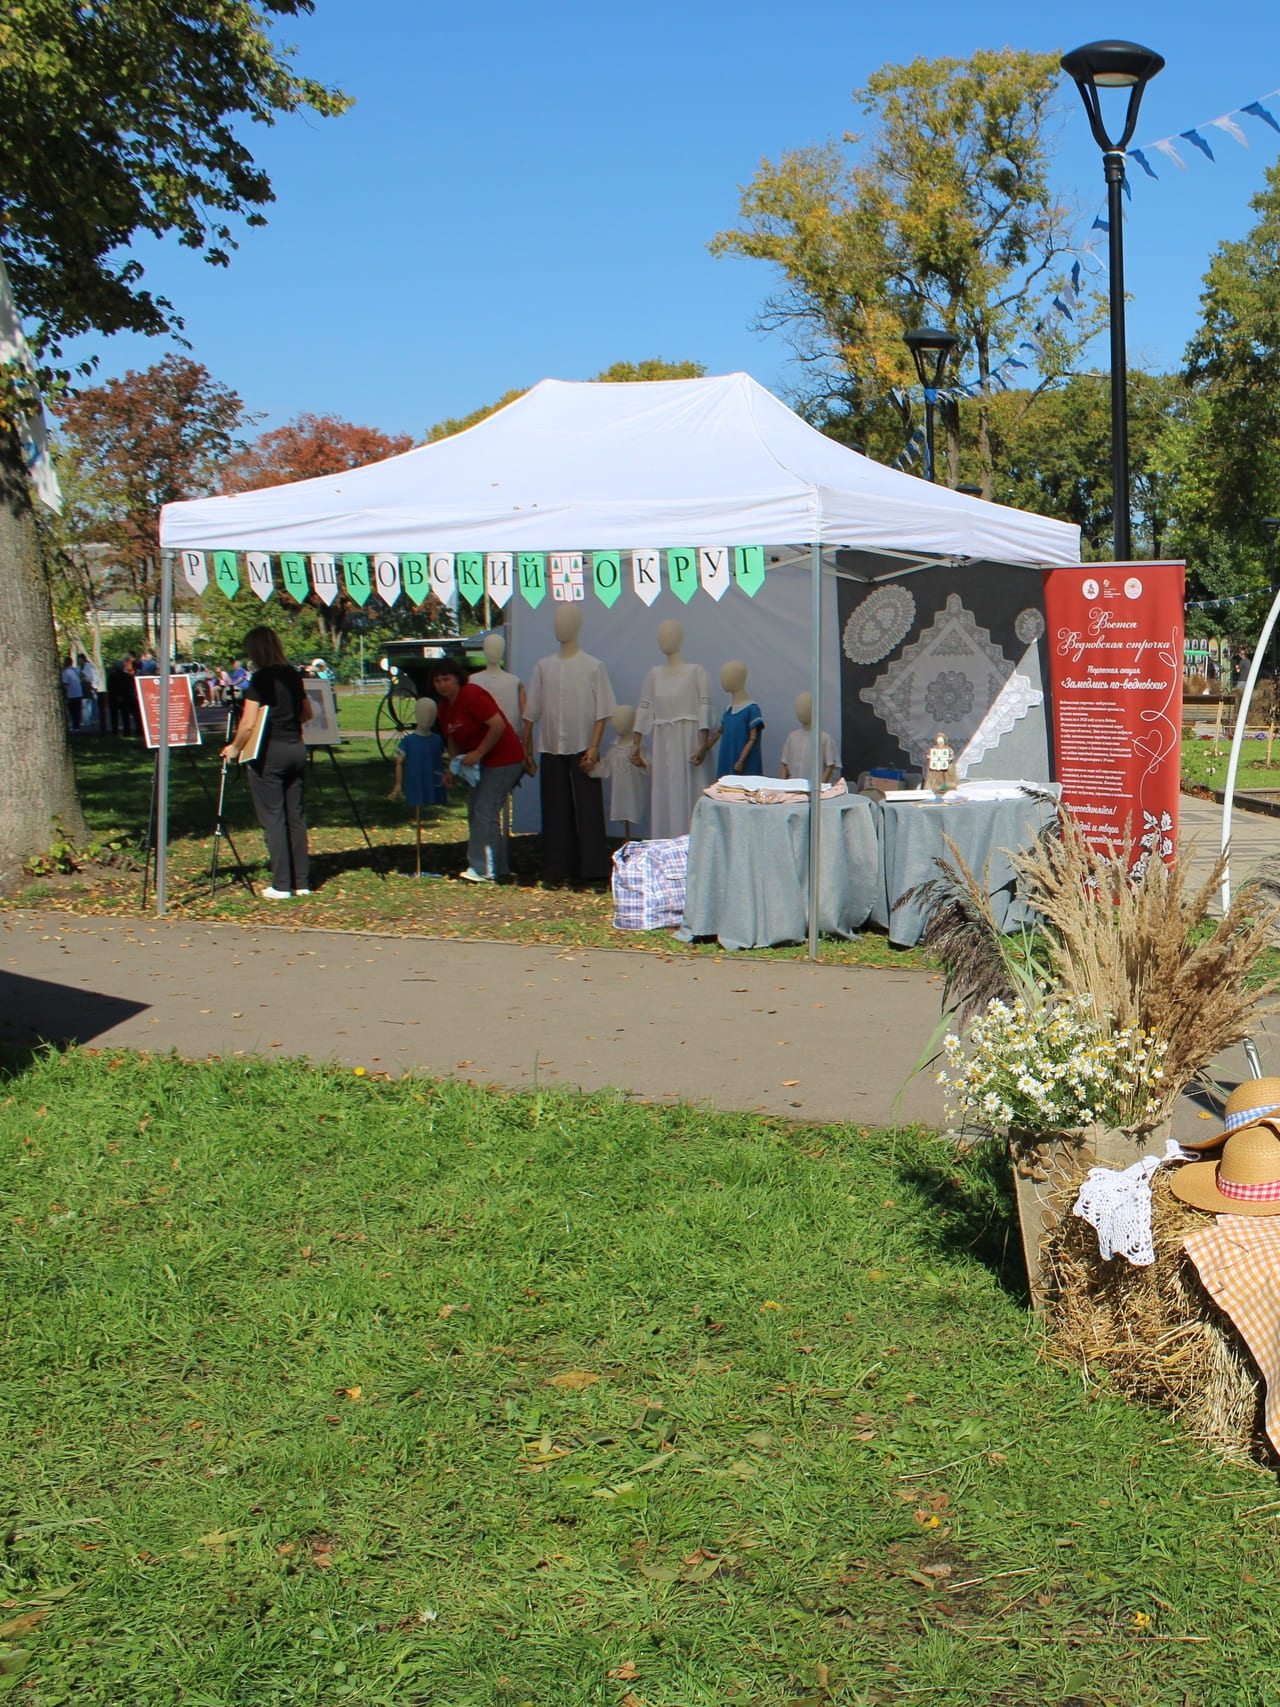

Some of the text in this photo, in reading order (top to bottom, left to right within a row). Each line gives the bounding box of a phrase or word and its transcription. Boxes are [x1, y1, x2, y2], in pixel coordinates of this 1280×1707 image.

[185, 546, 758, 588] РАМЕШКОВСКИЙ ОКРУГ
[1056, 627, 1171, 663] Ведновская строчка
